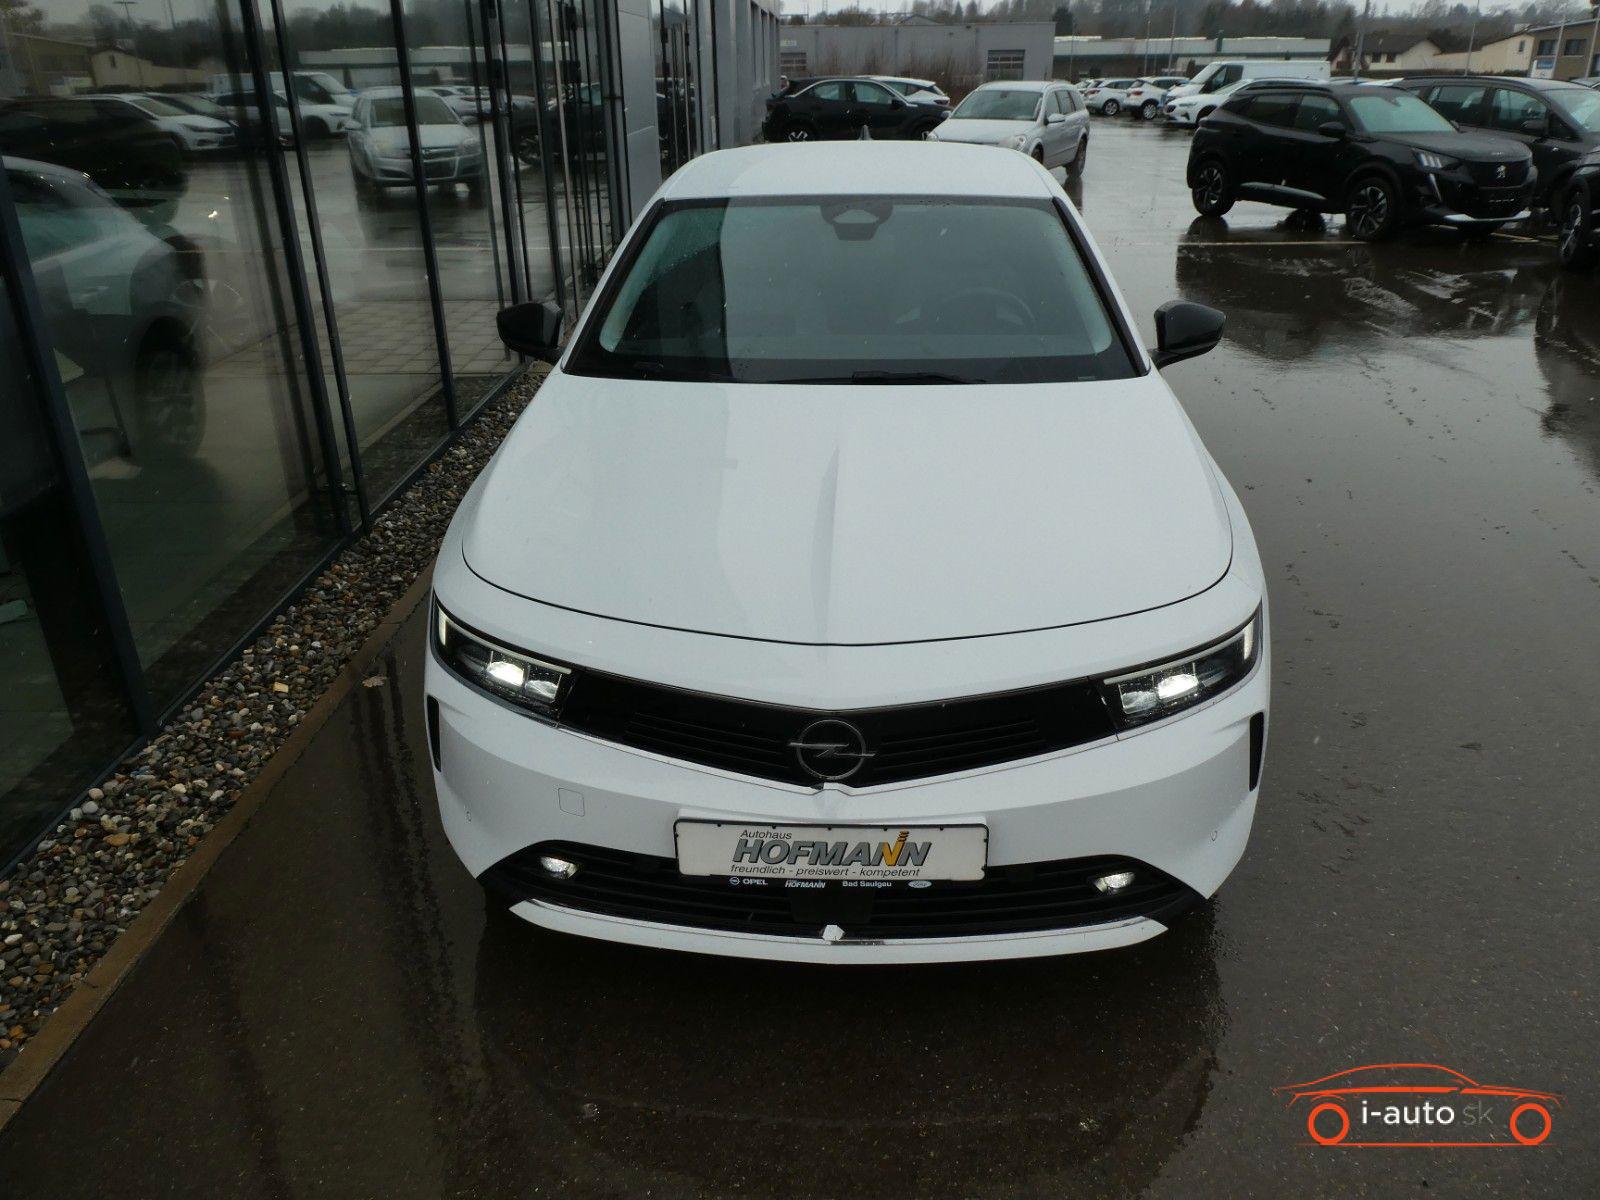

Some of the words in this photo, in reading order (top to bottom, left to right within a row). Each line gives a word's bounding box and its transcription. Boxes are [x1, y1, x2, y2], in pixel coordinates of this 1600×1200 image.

[740, 829, 792, 840] Autohaus
[732, 838, 932, 867] HOFMANN
[731, 864, 786, 874] freundlich
[796, 867, 850, 877] preiswert
[859, 868, 920, 878] kompetent
[742, 878, 768, 886] OPEL
[785, 880, 826, 888] HOFMANN
[860, 880, 892, 888] Saulgau
